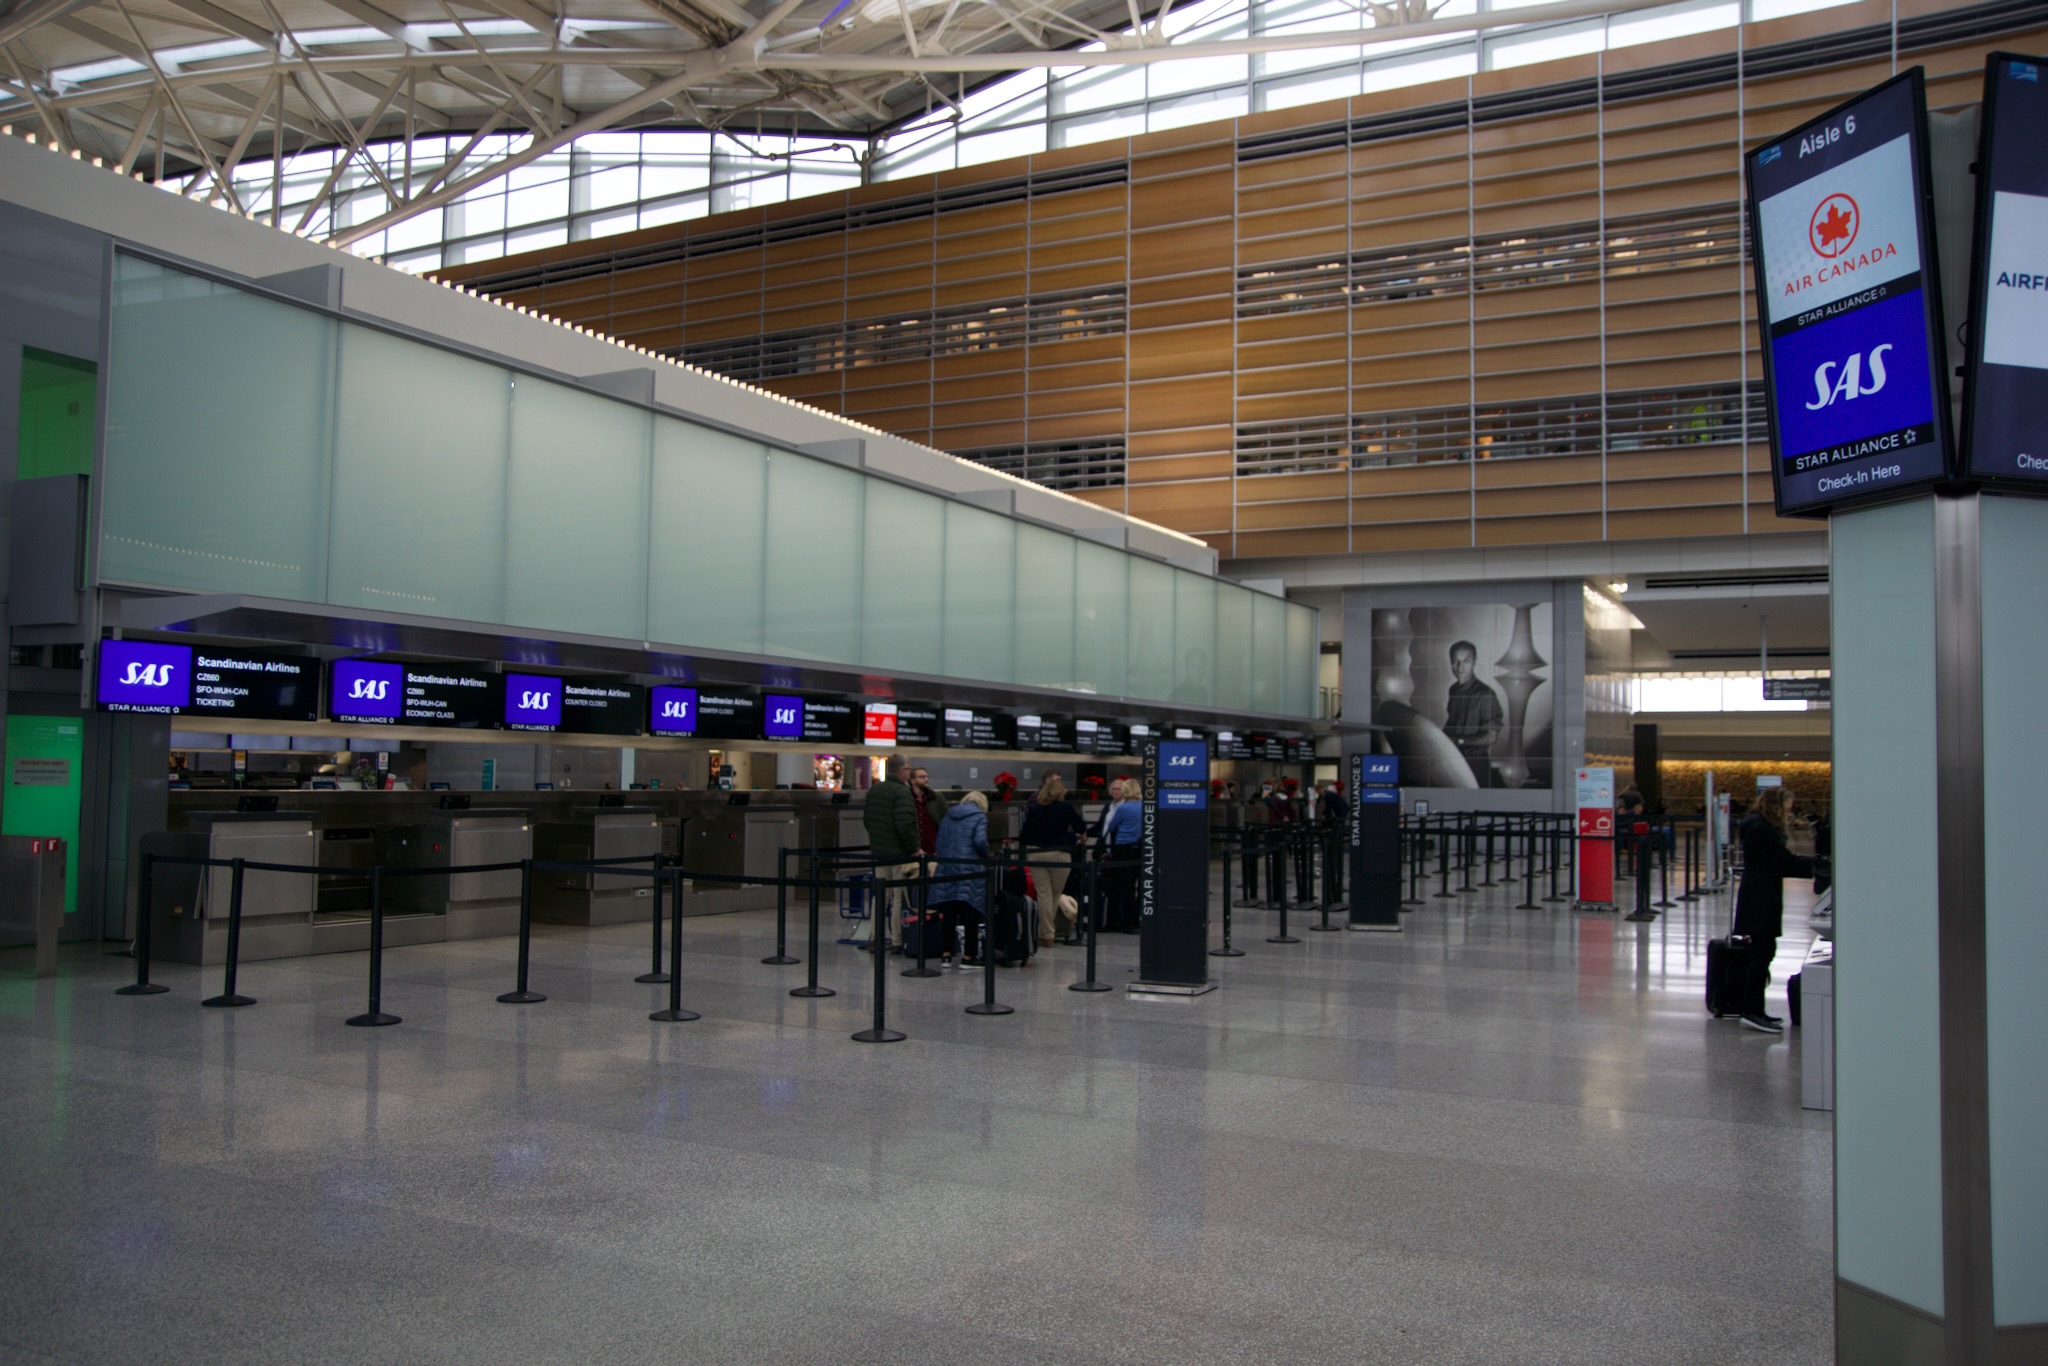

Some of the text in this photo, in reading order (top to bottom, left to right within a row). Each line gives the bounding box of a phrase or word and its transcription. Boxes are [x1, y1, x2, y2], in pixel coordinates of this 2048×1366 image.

[1798, 114, 1857, 158] Aisle 6
[1784, 242, 1898, 297] AIR CANADA
[1797, 290, 1878, 326] STAR ALLIANCE
[1805, 343, 1893, 411] SAS
[1795, 433, 1900, 470] STAR ALLIANCE
[1817, 462, 1901, 493] Check-In Here
[197, 656, 301, 674] Scandinavian Airlines
[119, 661, 174, 687] SAS
[407, 673, 488, 688] Scandinavian Airlines
[196, 685, 249, 696] SFO-WUH-CAN
[348, 678, 390, 700] SAS
[565, 685, 631, 699] Scandinavian Airlines
[195, 697, 235, 708] TICKETING
[406, 698, 447, 708] SFO-WUH-CAN
[518, 691, 552, 710] SAS
[565, 699, 608, 708] COUNTER CLOSED
[699, 695, 734, 705] Scandinavian
[108, 703, 171, 714] STAR ALLIANCE
[308, 712, 316, 720] 71
[405, 709, 455, 719] ECONOMY CLASS
[661, 700, 689, 718] SAS
[773, 708, 796, 724] SAS
[357, 716, 388, 724] ALLIANCE
[525, 724, 550, 732] ALLIANCE
[1168, 755, 1197, 766] SAS
[1369, 764, 1391, 773] SAS
[1145, 759, 1156, 799] GOLD
[1352, 767, 1361, 846] STAR ALLIANCE
[1143, 879, 1154, 916] STAR
